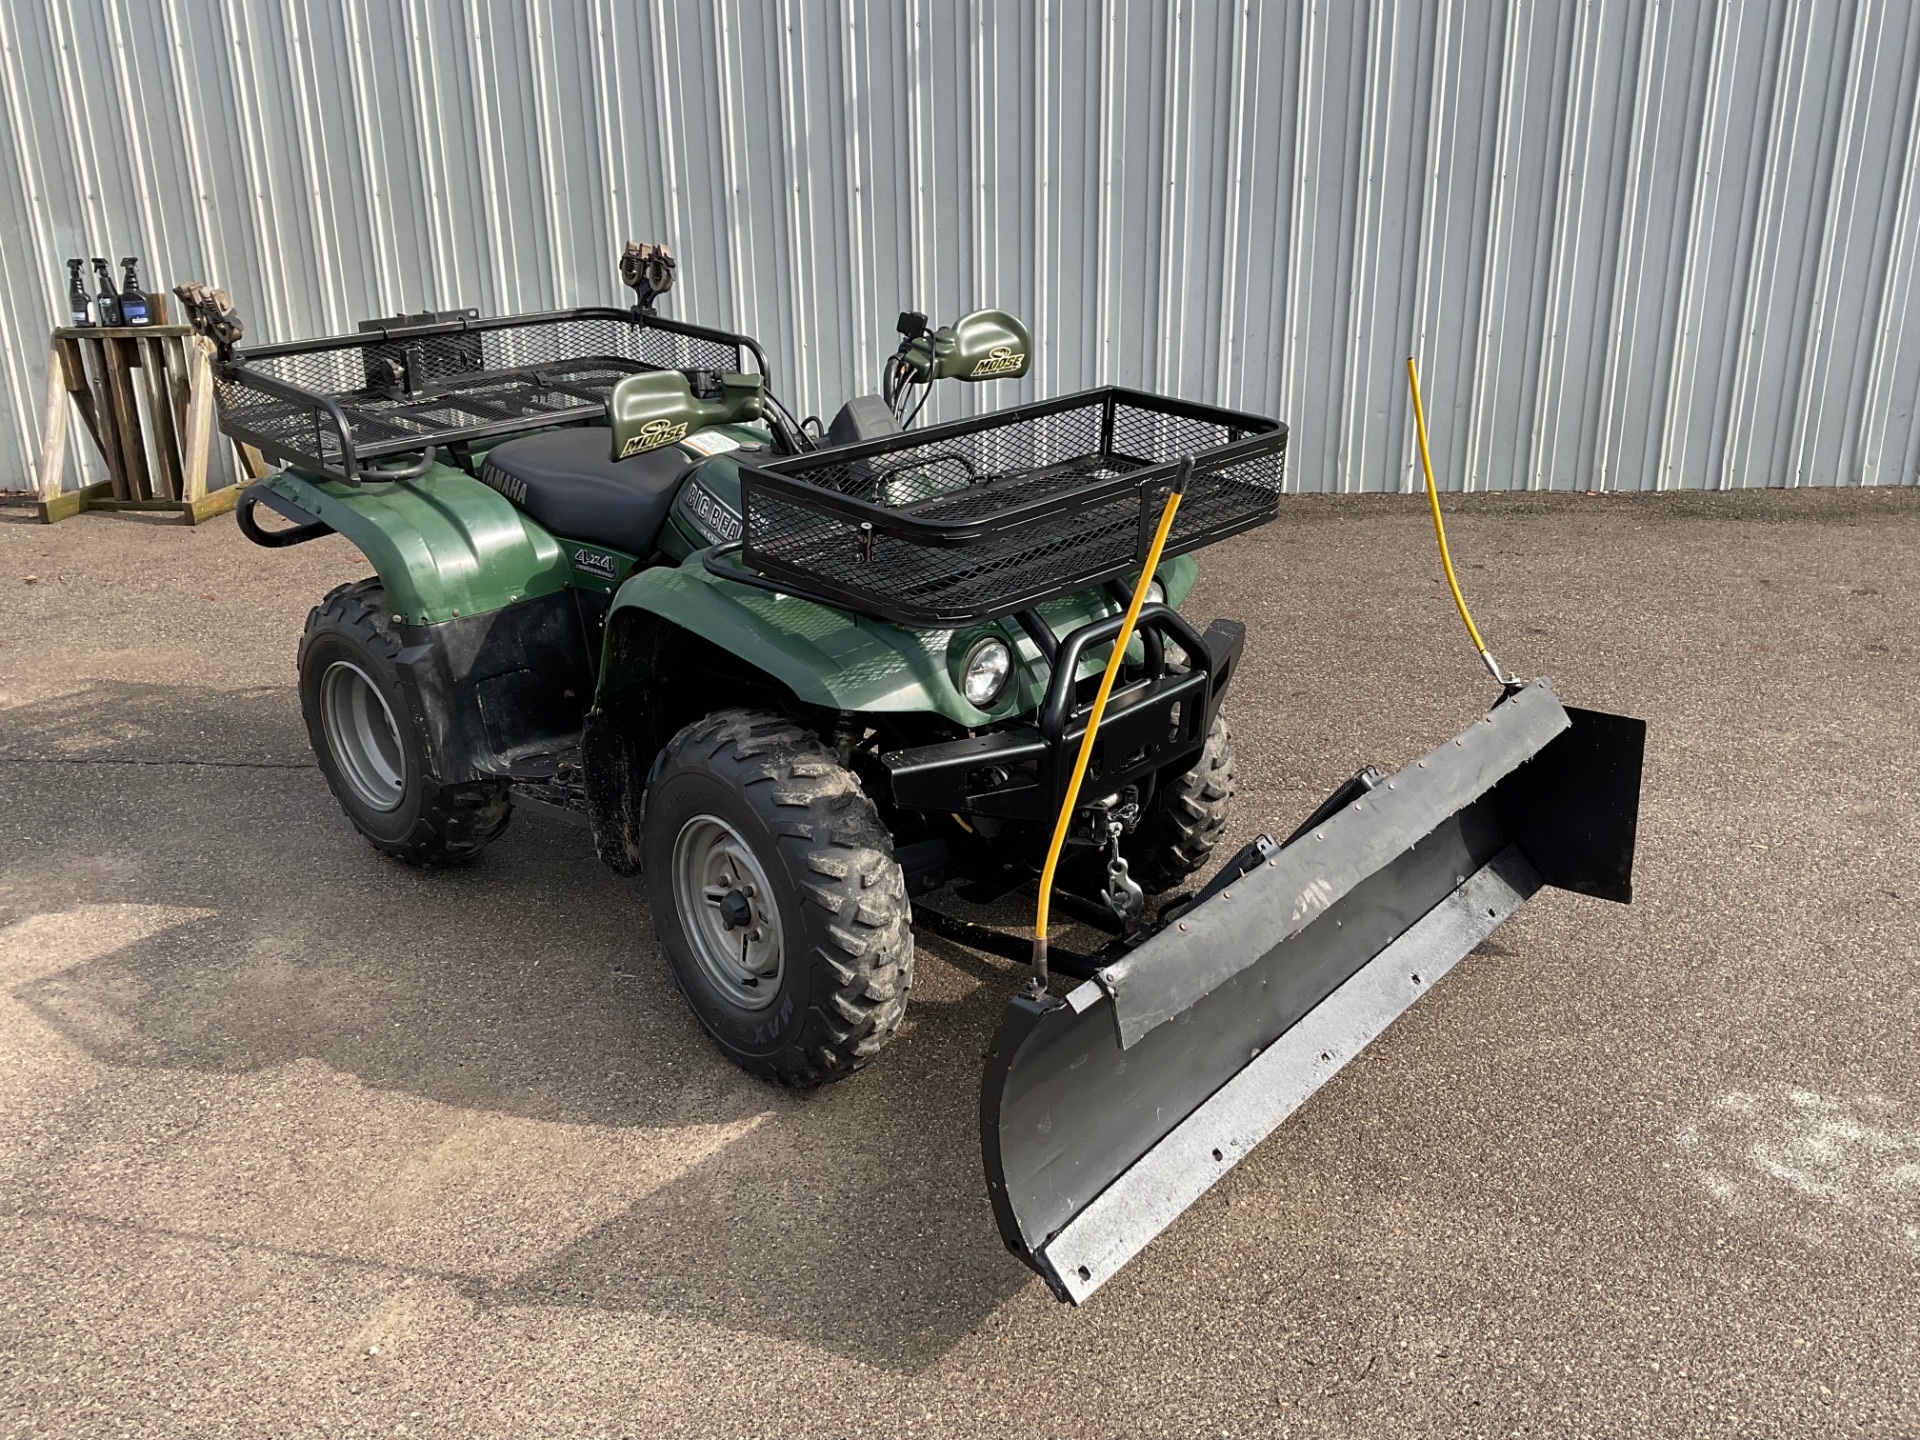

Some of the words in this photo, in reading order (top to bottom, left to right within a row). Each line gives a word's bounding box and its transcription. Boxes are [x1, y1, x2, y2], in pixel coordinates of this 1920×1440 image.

[976, 355, 1023, 371] MOOSE
[625, 423, 686, 452] MOOSE
[482, 462, 528, 504] YAMAHA
[687, 482, 711, 518] BIG
